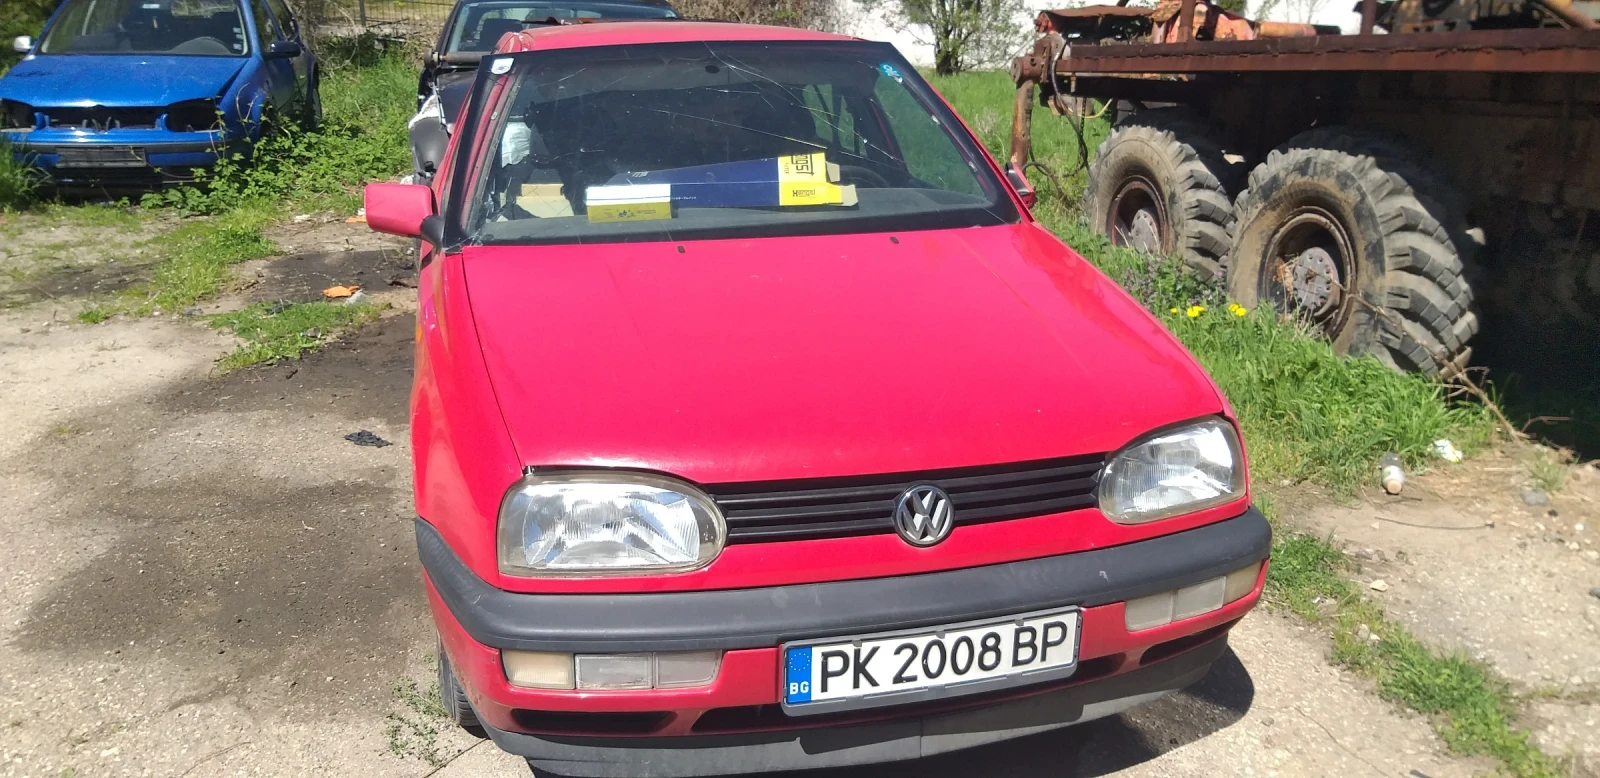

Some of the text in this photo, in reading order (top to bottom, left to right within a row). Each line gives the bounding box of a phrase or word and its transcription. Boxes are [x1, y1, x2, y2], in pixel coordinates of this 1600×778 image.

[899, 487, 951, 543] VW
[820, 620, 1068, 693] PK 2008 BP
[789, 682, 809, 695] BG
